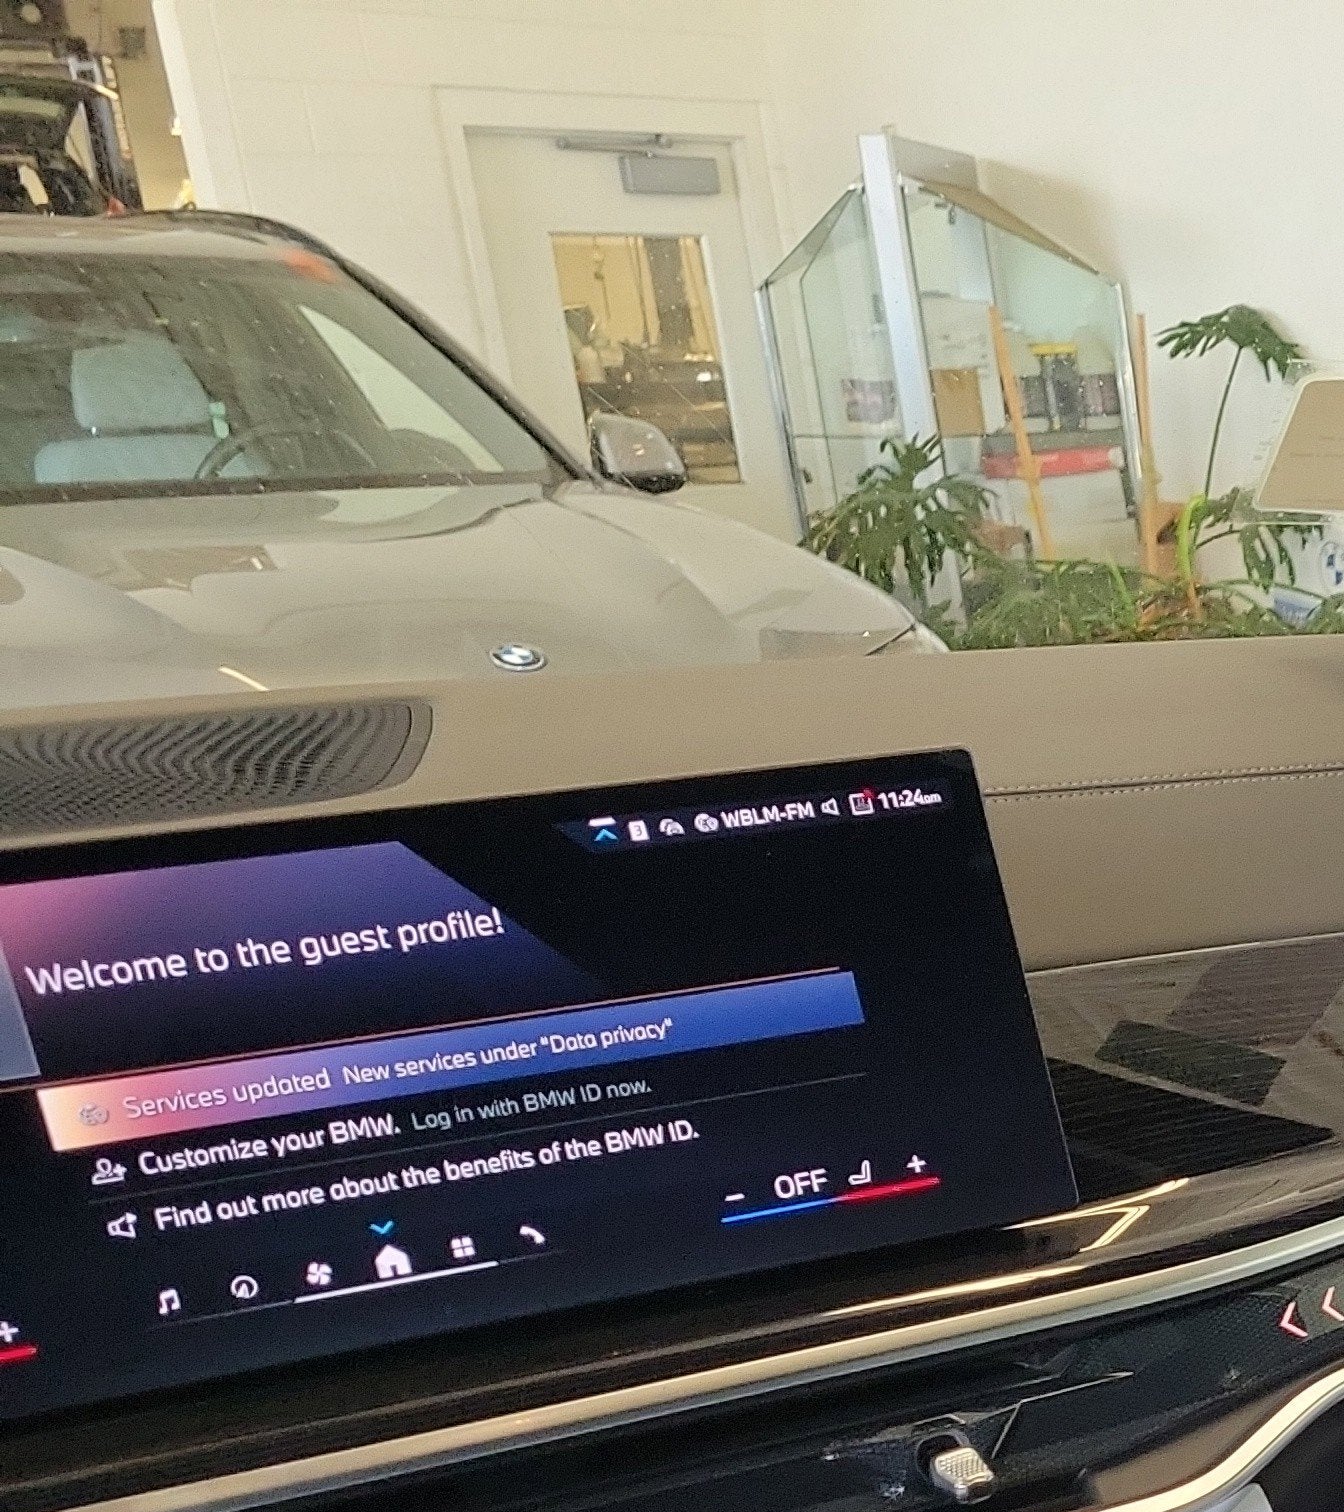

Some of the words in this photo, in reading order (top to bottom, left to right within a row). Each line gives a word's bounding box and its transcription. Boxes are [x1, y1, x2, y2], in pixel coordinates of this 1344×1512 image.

[719, 800, 816, 829] WBLM-FM
[25, 954, 188, 995] Welcome
[197, 946, 230, 974] to
[236, 938, 293, 968] the
[299, 923, 392, 967] guest
[397, 906, 505, 953] profile!
[122, 1086, 227, 1120] Services
[232, 1067, 331, 1104] updated
[342, 1061, 390, 1086] New
[394, 1050, 477, 1079] services
[480, 1041, 538, 1065] under
[138, 1138, 268, 1175] Customize
[271, 1128, 325, 1158] your
[329, 1113, 401, 1145] BMW.
[411, 1111, 451, 1131] Log
[454, 1104, 475, 1123] in
[477, 1097, 520, 1120] with
[522, 1086, 576, 1113] BMW
[579, 1083, 601, 1103] ID
[606, 1079, 652, 1100] now.
[154, 1202, 212, 1231] Find
[217, 1196, 259, 1221] out
[262, 1185, 326, 1212] more
[329, 1171, 400, 1202] about
[401, 1164, 442, 1190] the
[444, 1149, 536, 1182] benefits
[538, 1141, 564, 1165] of
[565, 1138, 603, 1161] the
[604, 1122, 665, 1153] BMW
[667, 1119, 701, 1142] ID.
[773, 1167, 829, 1199] OFF
